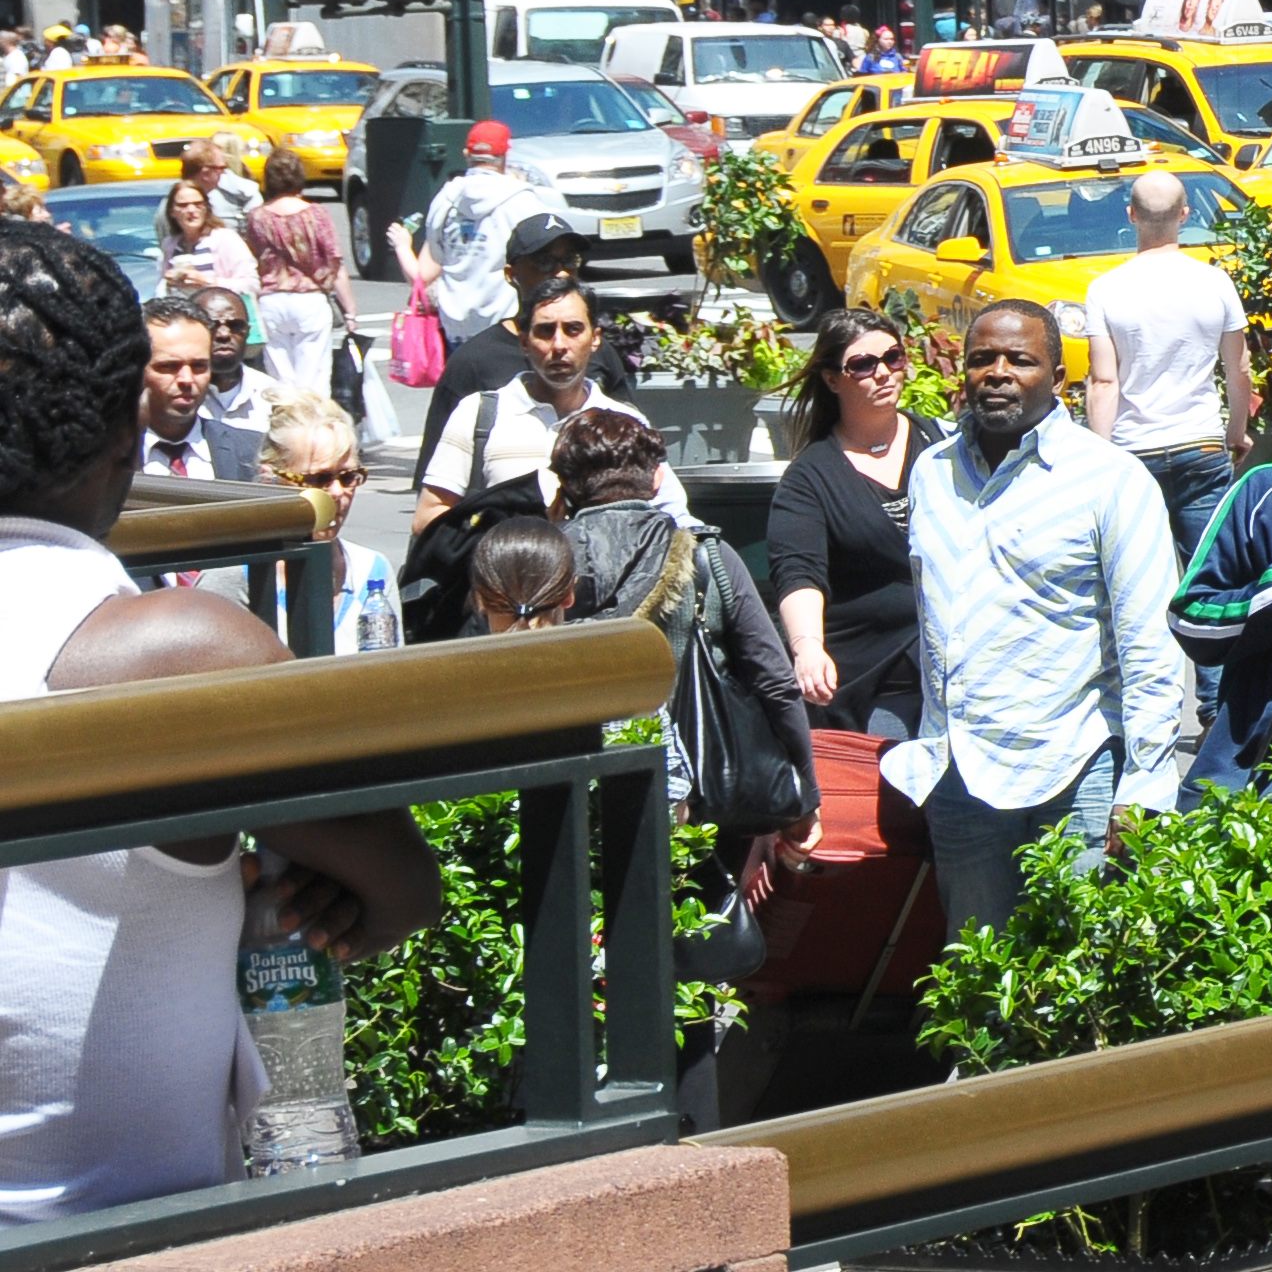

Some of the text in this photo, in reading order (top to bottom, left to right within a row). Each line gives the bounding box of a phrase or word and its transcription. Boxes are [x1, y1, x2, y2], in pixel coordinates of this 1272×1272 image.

[1084, 135, 1122, 155] 4N96
[250, 948, 309, 969] Poland
[245, 964, 318, 994] Spring
